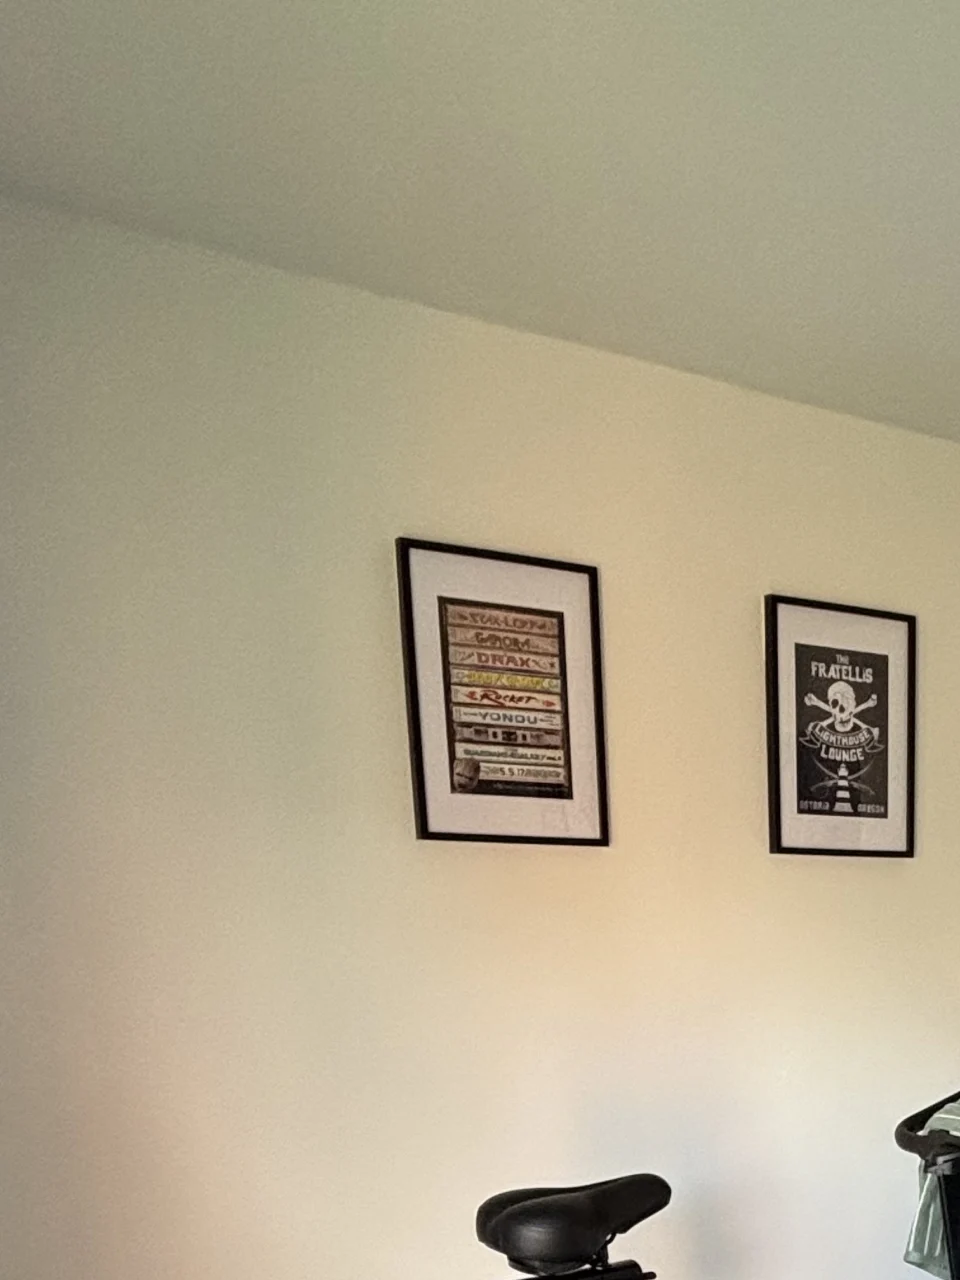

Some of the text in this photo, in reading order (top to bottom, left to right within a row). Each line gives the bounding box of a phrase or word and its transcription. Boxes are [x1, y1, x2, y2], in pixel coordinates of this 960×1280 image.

[476, 652, 531, 667] DRAX
[478, 711, 538, 724] YONDU
[820, 744, 865, 762] LOUNGE
